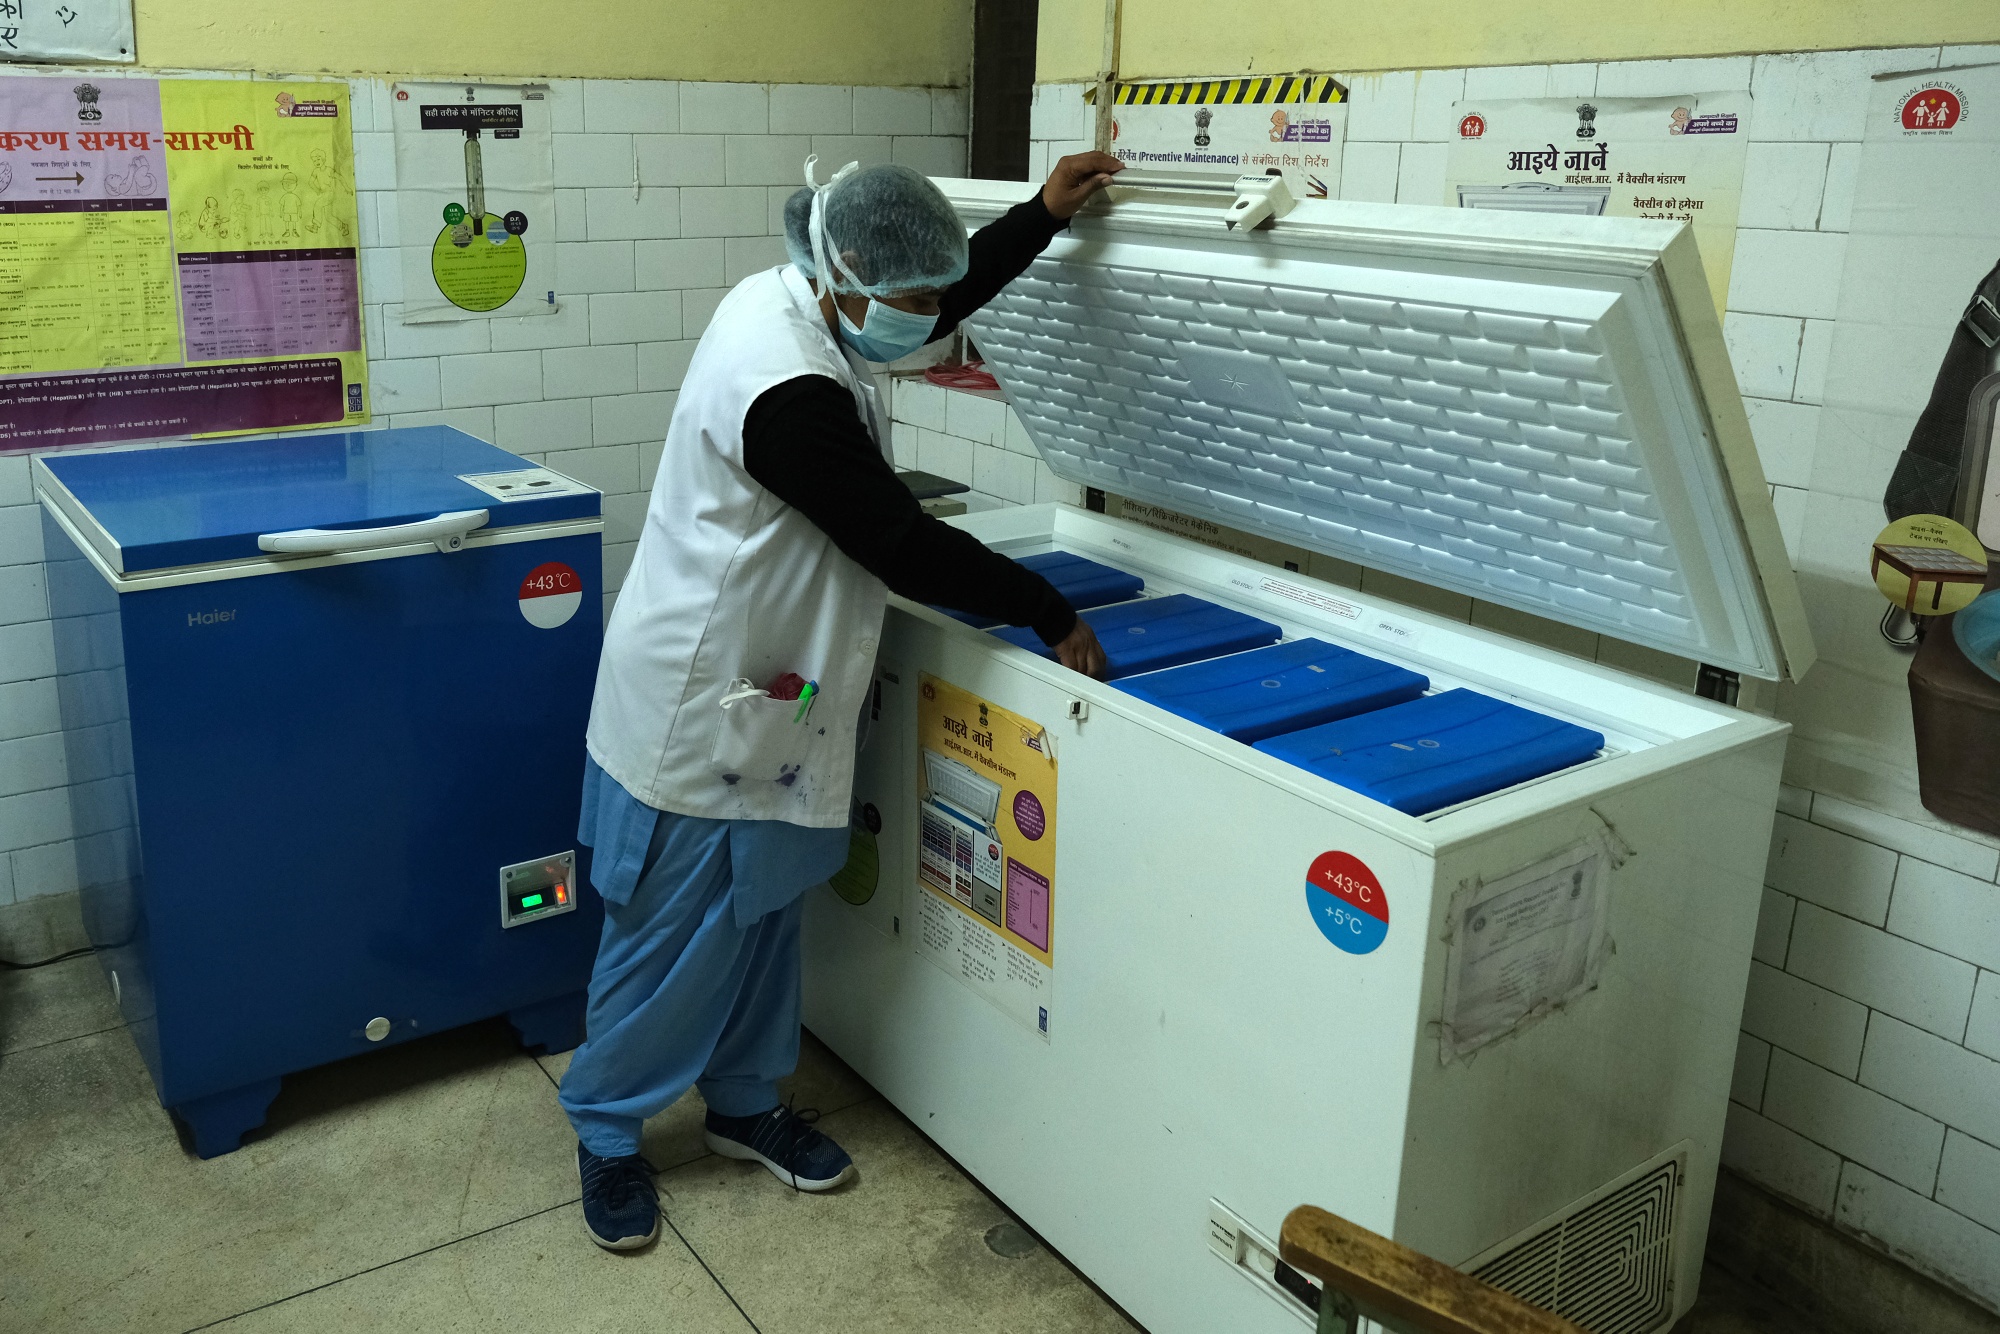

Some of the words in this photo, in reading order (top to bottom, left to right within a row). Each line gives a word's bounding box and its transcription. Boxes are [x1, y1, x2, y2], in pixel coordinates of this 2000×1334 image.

[1894, 87, 1920, 123] NATIONAL
[1922, 81, 1956, 90] HEALTH
[1954, 88, 1969, 122] MISSION
[424, 108, 438, 117] सही
[440, 107, 459, 117] तरीके
[461, 107, 467, 116] से
[470, 107, 494, 116] मॉनिटर
[496, 107, 518, 116] कीजिए
[1290, 126, 1305, 134] अने
[1139, 152, 1182, 162] (Preventive
[1184, 153, 1239, 166] Maintenance)
[1242, 155, 1249, 165] से
[1506, 144, 1560, 174] आइये
[1564, 142, 1609, 171] जानें
[1626, 172, 1654, 184] वैक्सीन
[1657, 173, 1686, 184] भंडारण
[1633, 196, 1662, 209] वैक्सीन
[1665, 197, 1676, 209] को
[1678, 198, 1704, 210] हमेशा
[50, 394, 77, 402] (Hepatitis
[207, 383, 232, 392] (Hepatitis
[188, 609, 236, 626] Haier
[1379, 623, 1393, 631] OPEN
[942, 715, 968, 739] आइये
[972, 731, 993, 752] जानें
[1325, 870, 1371, 903] +43°C
[1325, 907, 1362, 934] +5°C
[1212, 1231, 1232, 1250] Denmark
